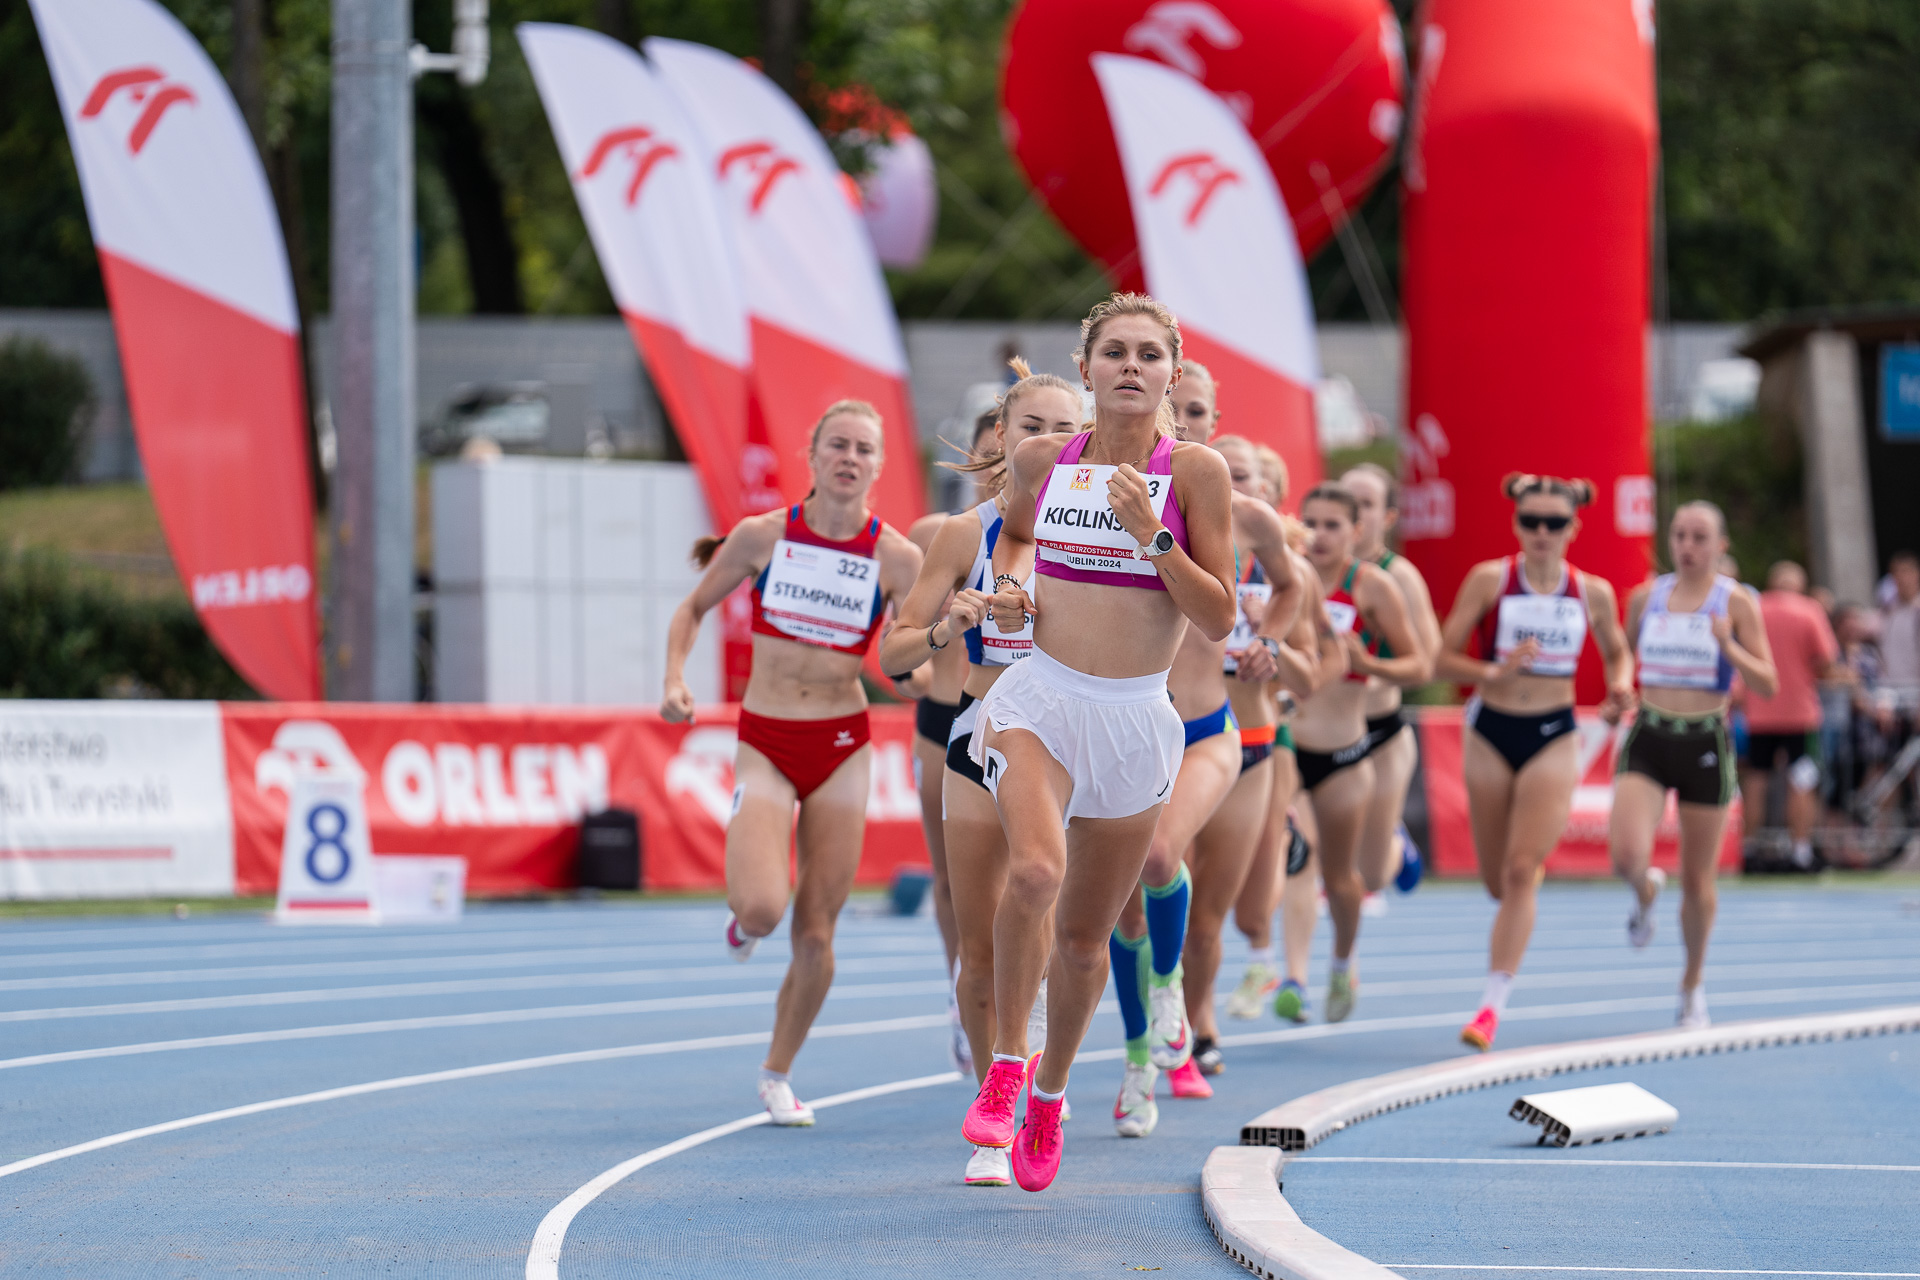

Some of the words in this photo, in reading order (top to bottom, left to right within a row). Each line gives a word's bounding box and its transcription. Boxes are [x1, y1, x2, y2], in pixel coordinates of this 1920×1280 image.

[1070, 482, 1089, 490] PZLA
[1044, 505, 1129, 533] KICILIŃS
[1063, 544, 1112, 556] MISTRZOSTWA
[1113, 550, 1135, 558] POLSK
[1066, 555, 1096, 566] LUBLIN
[1097, 559, 1122, 569] 2024
[837, 558, 870, 581] 322
[773, 581, 865, 613] STEMPNIAK
[995, 640, 1010, 648] PZLA
[383, 740, 609, 827] ORLEN
[306, 803, 351, 885] 8
